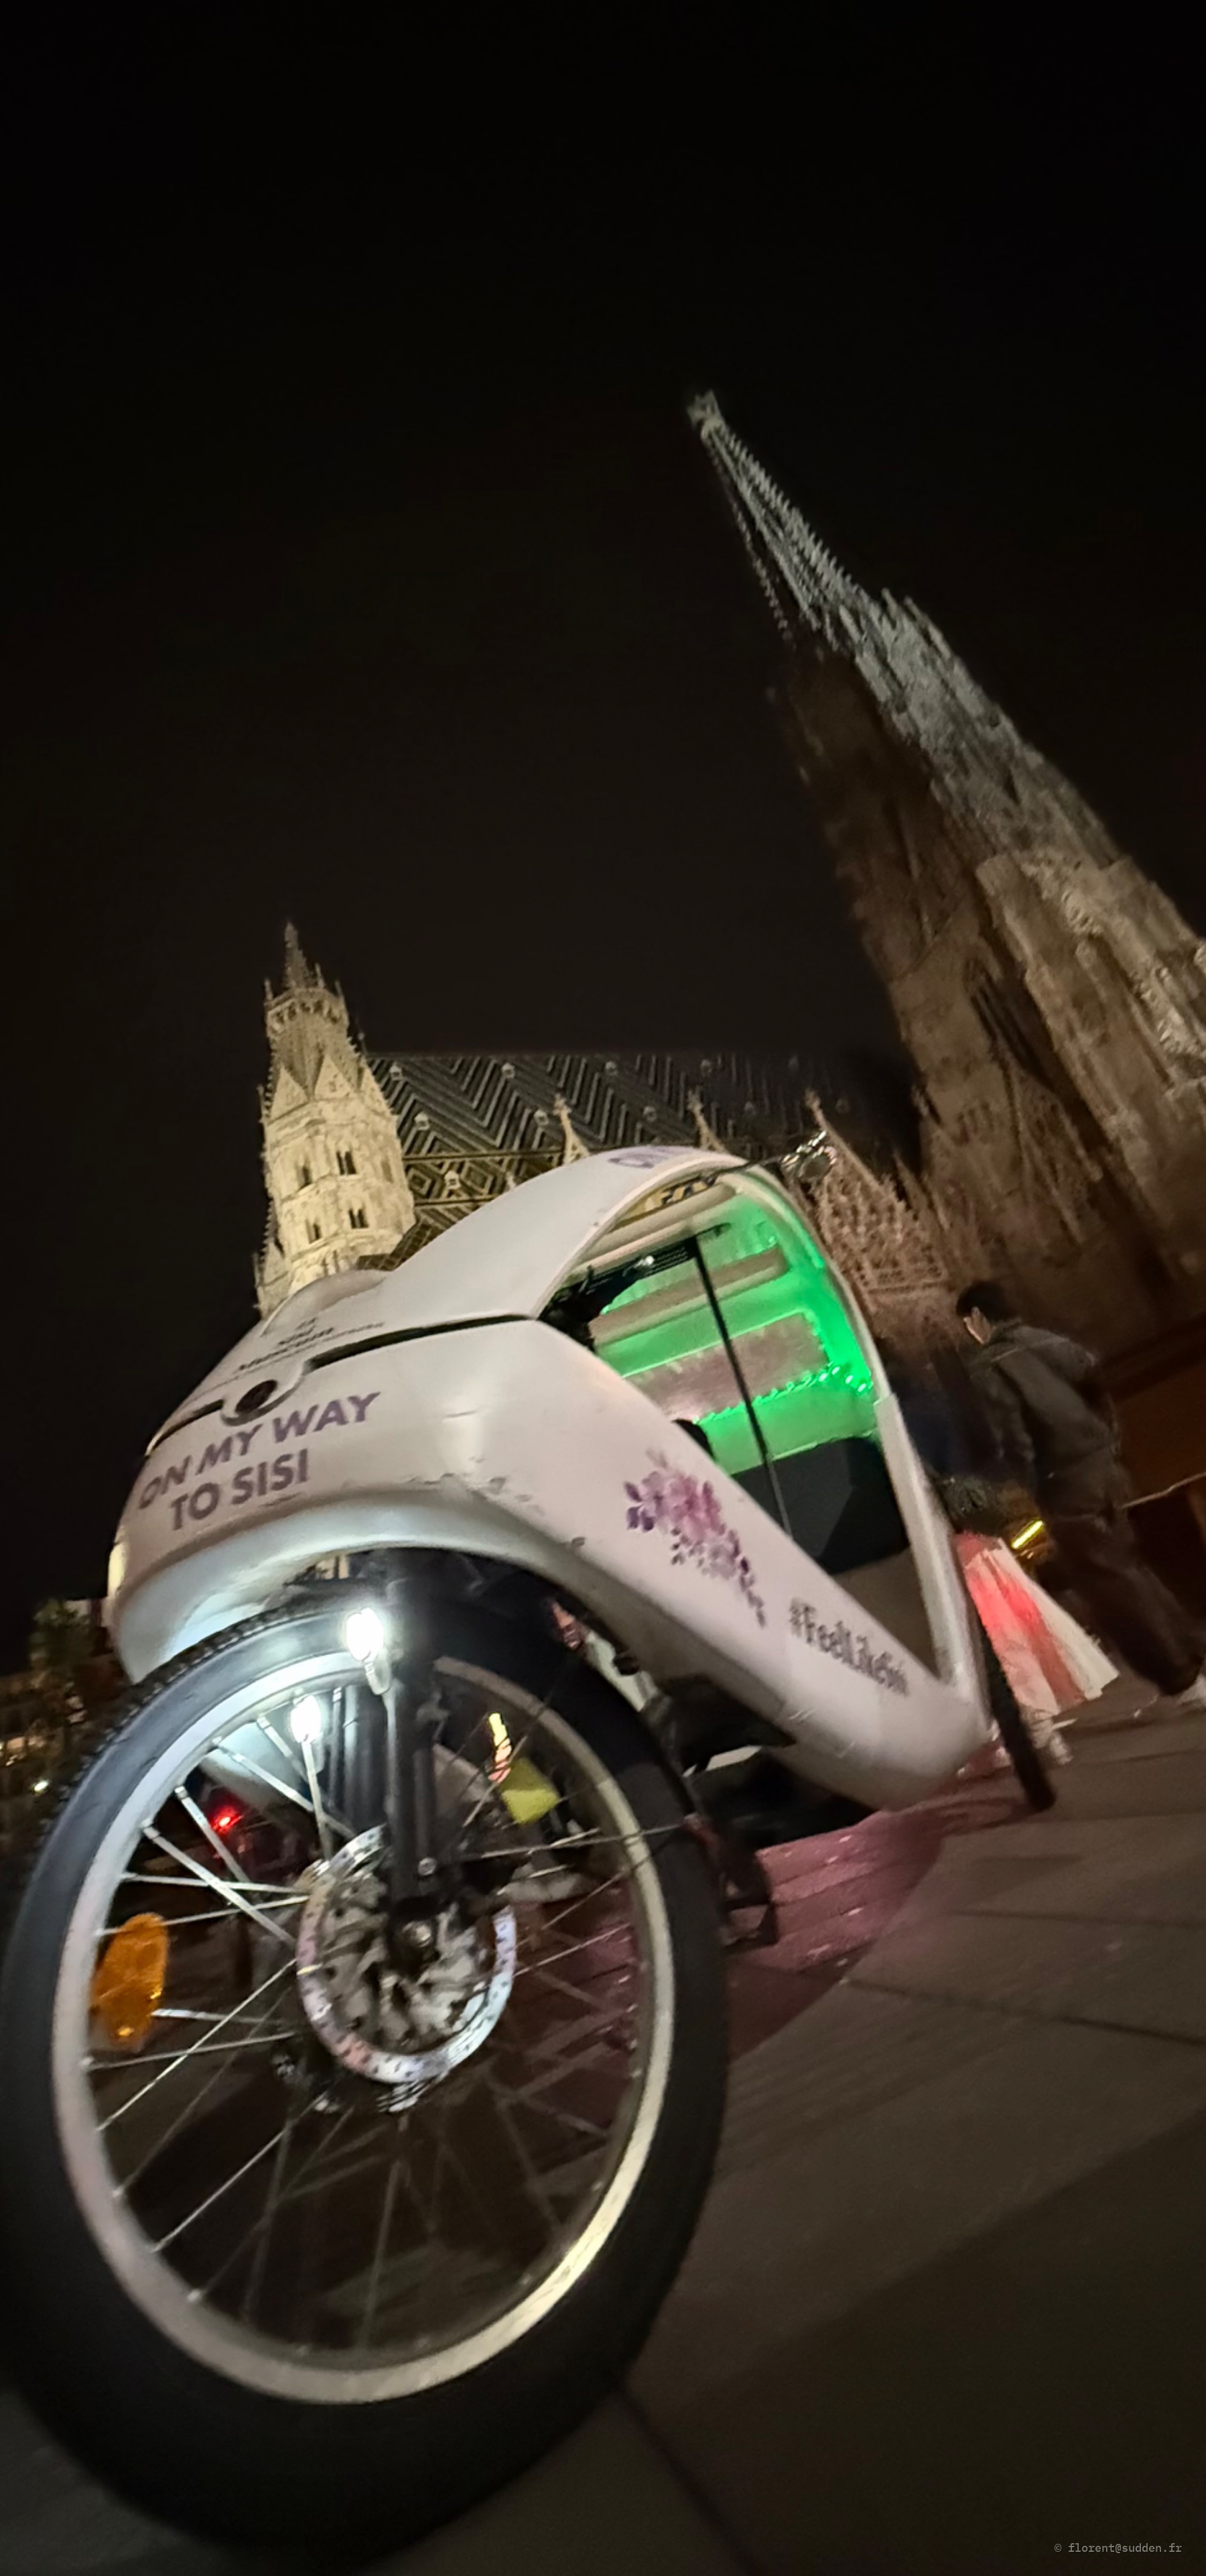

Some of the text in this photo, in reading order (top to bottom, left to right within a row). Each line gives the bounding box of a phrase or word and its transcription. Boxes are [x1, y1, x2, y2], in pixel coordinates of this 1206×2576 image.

[139, 1392, 381, 1509] ON MY WAY
[170, 1449, 309, 1530] TO SISI
